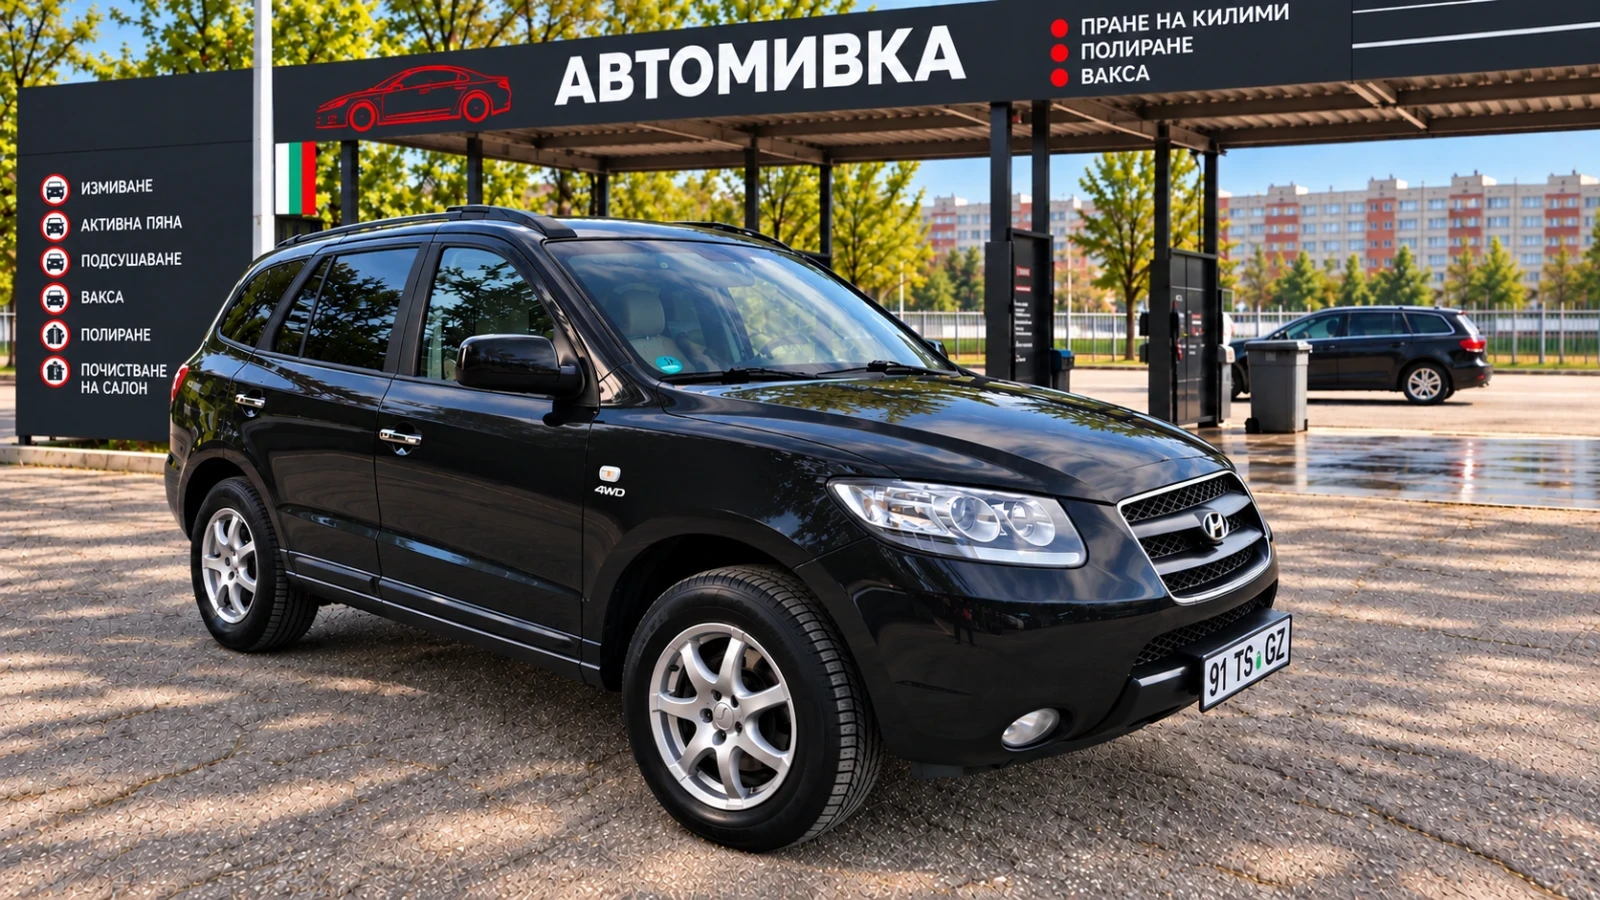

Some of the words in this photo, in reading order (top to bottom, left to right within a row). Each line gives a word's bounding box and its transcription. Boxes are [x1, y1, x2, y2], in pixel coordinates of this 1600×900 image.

[1081, 14, 1150, 36] ПРАНЕ
[1156, 12, 1187, 30] НА
[1192, 3, 1290, 27] КИЛИМИ
[1081, 36, 1194, 60] ПОЛИРАНЕ
[554, 25, 967, 106] АВТОМИВКА
[1081, 64, 1151, 85] ВАКСА
[81, 178, 153, 195] ИЗМИВАНЕ
[80, 216, 142, 232] АКТИВНА
[146, 215, 183, 230] ПЯНА
[81, 252, 182, 269] ПОДСУШАВАНЕ
[81, 290, 125, 304] ВАКСА
[81, 328, 151, 342] ПОЛИРАНЕ
[81, 363, 168, 378] ПОЧИСТВАНЕ
[81, 381, 99, 394] НА
[102, 381, 148, 395] САЛОН
[594, 485, 626, 498] 4WD
[1209, 657, 1227, 697] 91
[1234, 645, 1253, 682] TS
[1265, 627, 1285, 665] GZ
